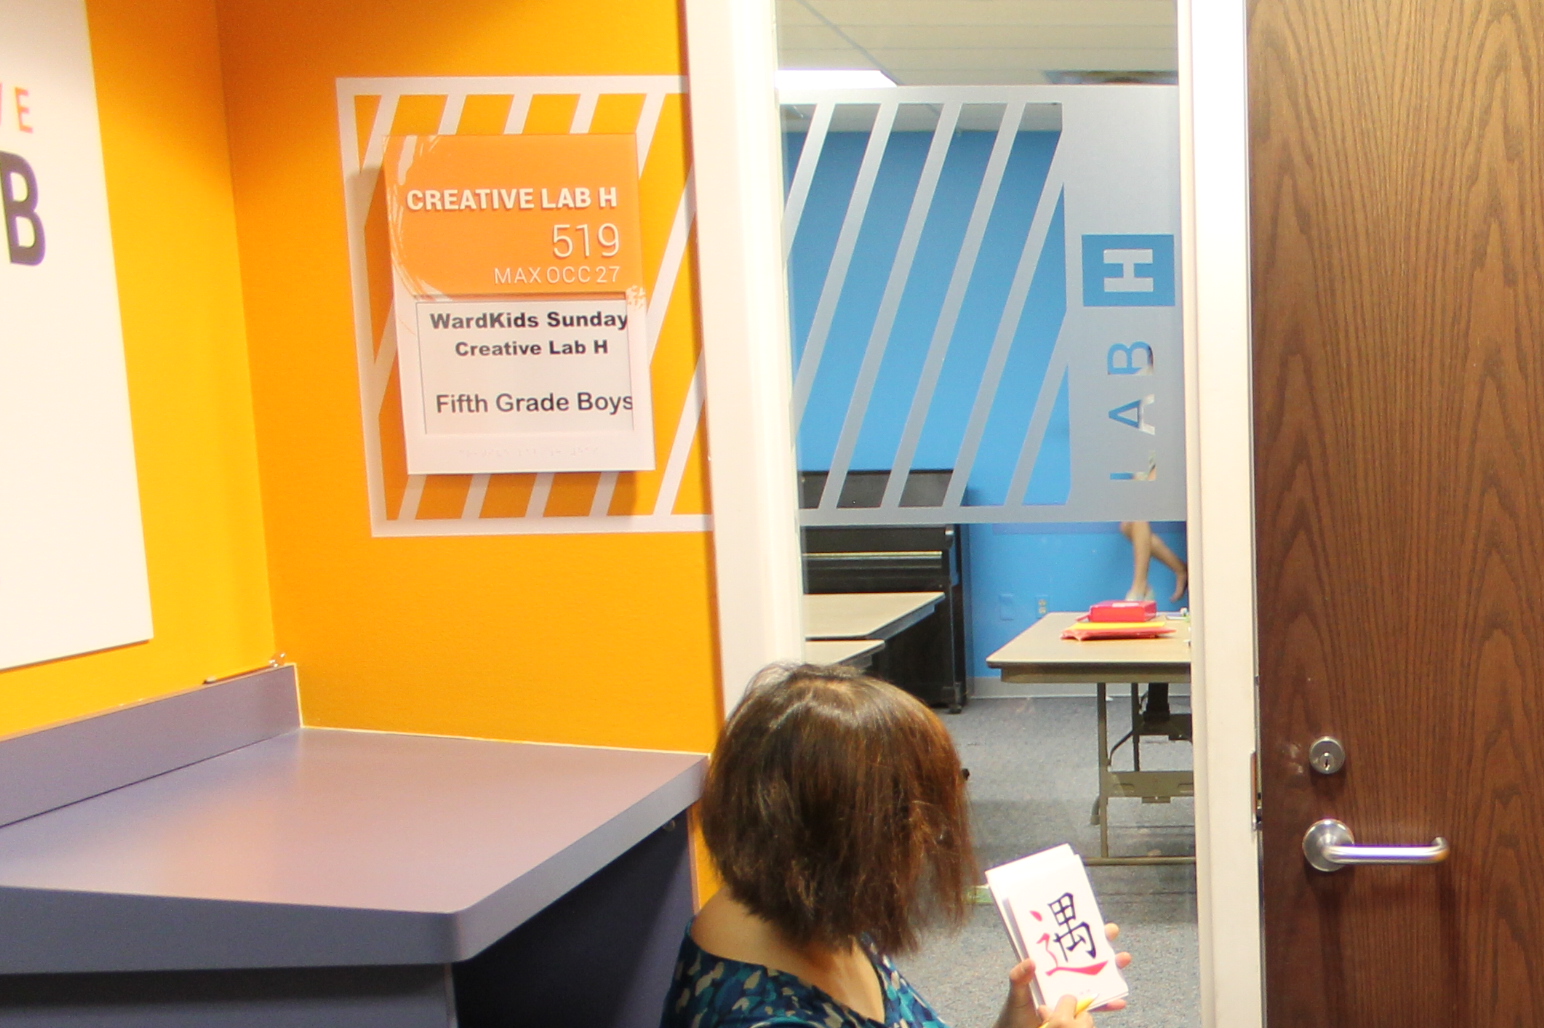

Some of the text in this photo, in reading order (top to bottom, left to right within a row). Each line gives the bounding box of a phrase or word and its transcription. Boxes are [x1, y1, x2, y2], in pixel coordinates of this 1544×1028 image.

[406, 186, 618, 211] CREATIVE LAB H
[552, 222, 621, 259] 519
[494, 265, 621, 284] MAX OCC 27
[429, 310, 628, 331] WardKids Sunday
[455, 339, 609, 357] Creative Lab H
[1103, 248, 1157, 481] LAB H
[435, 391, 633, 415] Fifth Grade Boys
[1029, 892, 1109, 976] 遇
